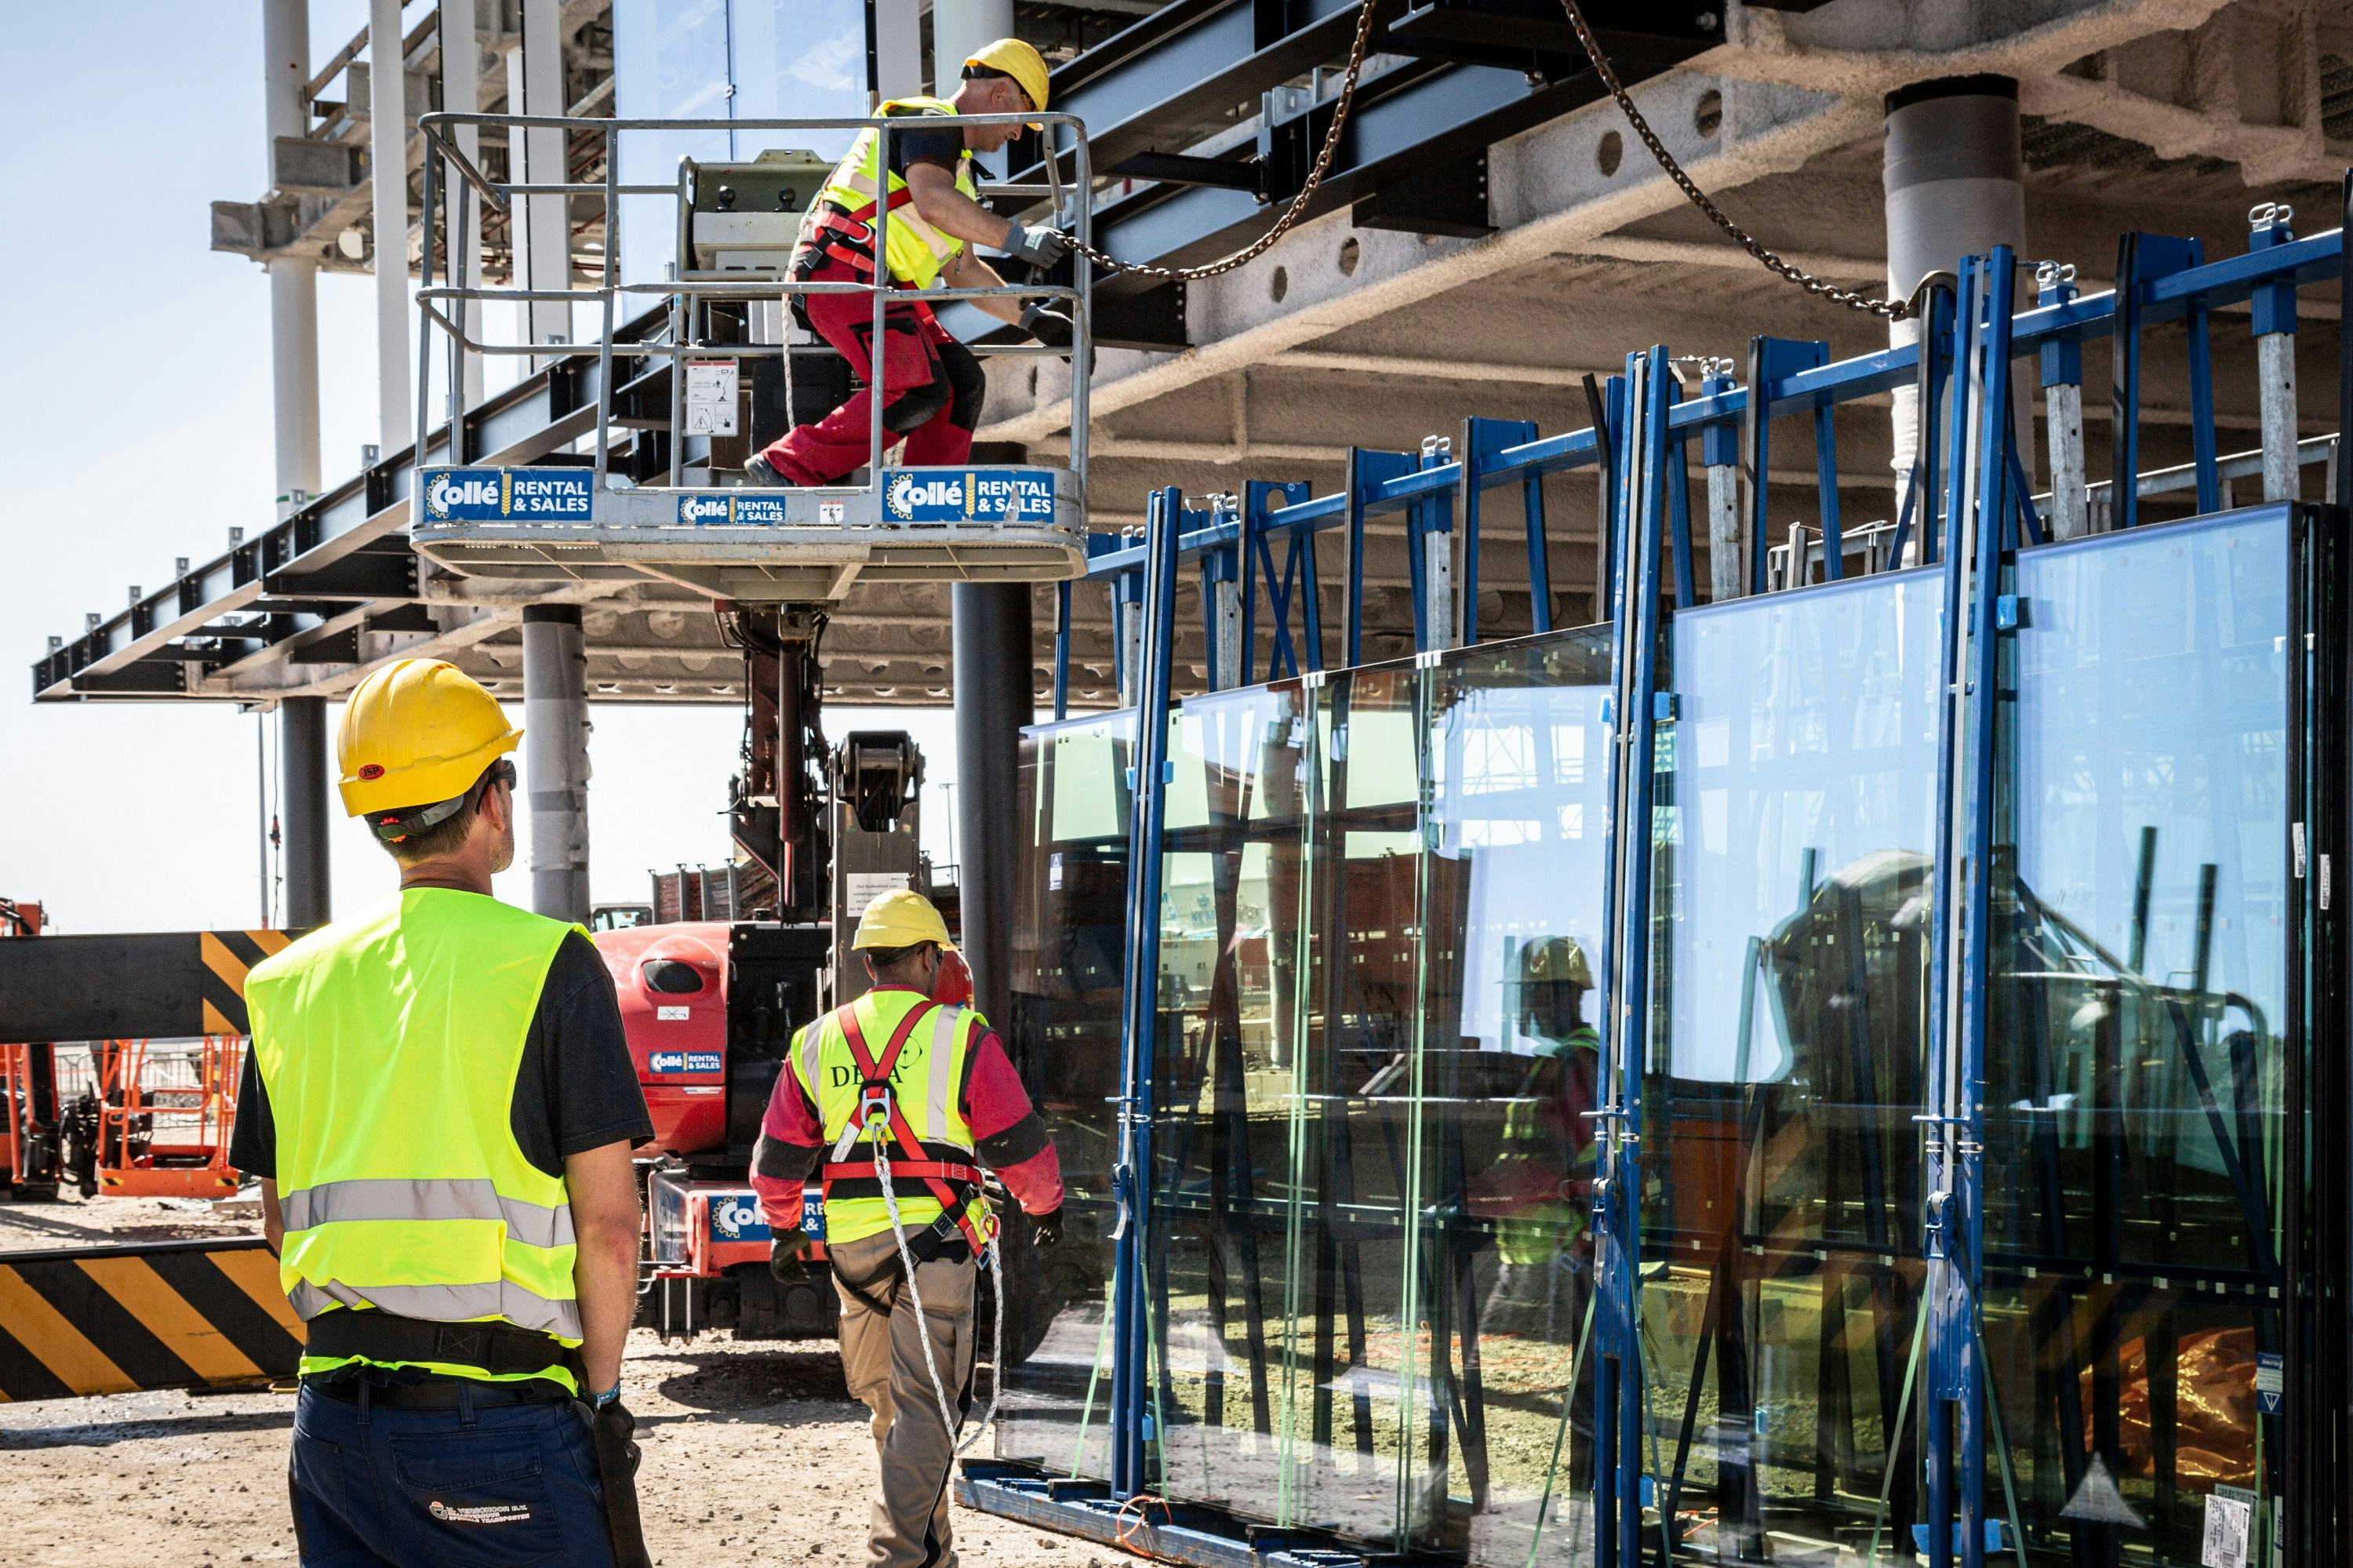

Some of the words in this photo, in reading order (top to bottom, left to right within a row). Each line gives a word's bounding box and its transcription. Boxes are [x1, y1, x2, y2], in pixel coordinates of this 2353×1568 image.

[431, 478, 498, 513] Collé
[515, 481, 588, 496] RENTAL
[978, 481, 1051, 497] RENTAL
[893, 479, 962, 514] Collé
[514, 499, 526, 512] &
[530, 497, 588, 512] SALES
[684, 499, 728, 521] Collé
[737, 501, 783, 511] RENTAL
[977, 499, 991, 513] &
[736, 511, 745, 521] &
[747, 511, 784, 522] SALES
[363, 766, 380, 777] JSP
[653, 1053, 682, 1070] Collé
[688, 1054, 720, 1063] RENTAL
[806, 1217, 819, 1231] &
